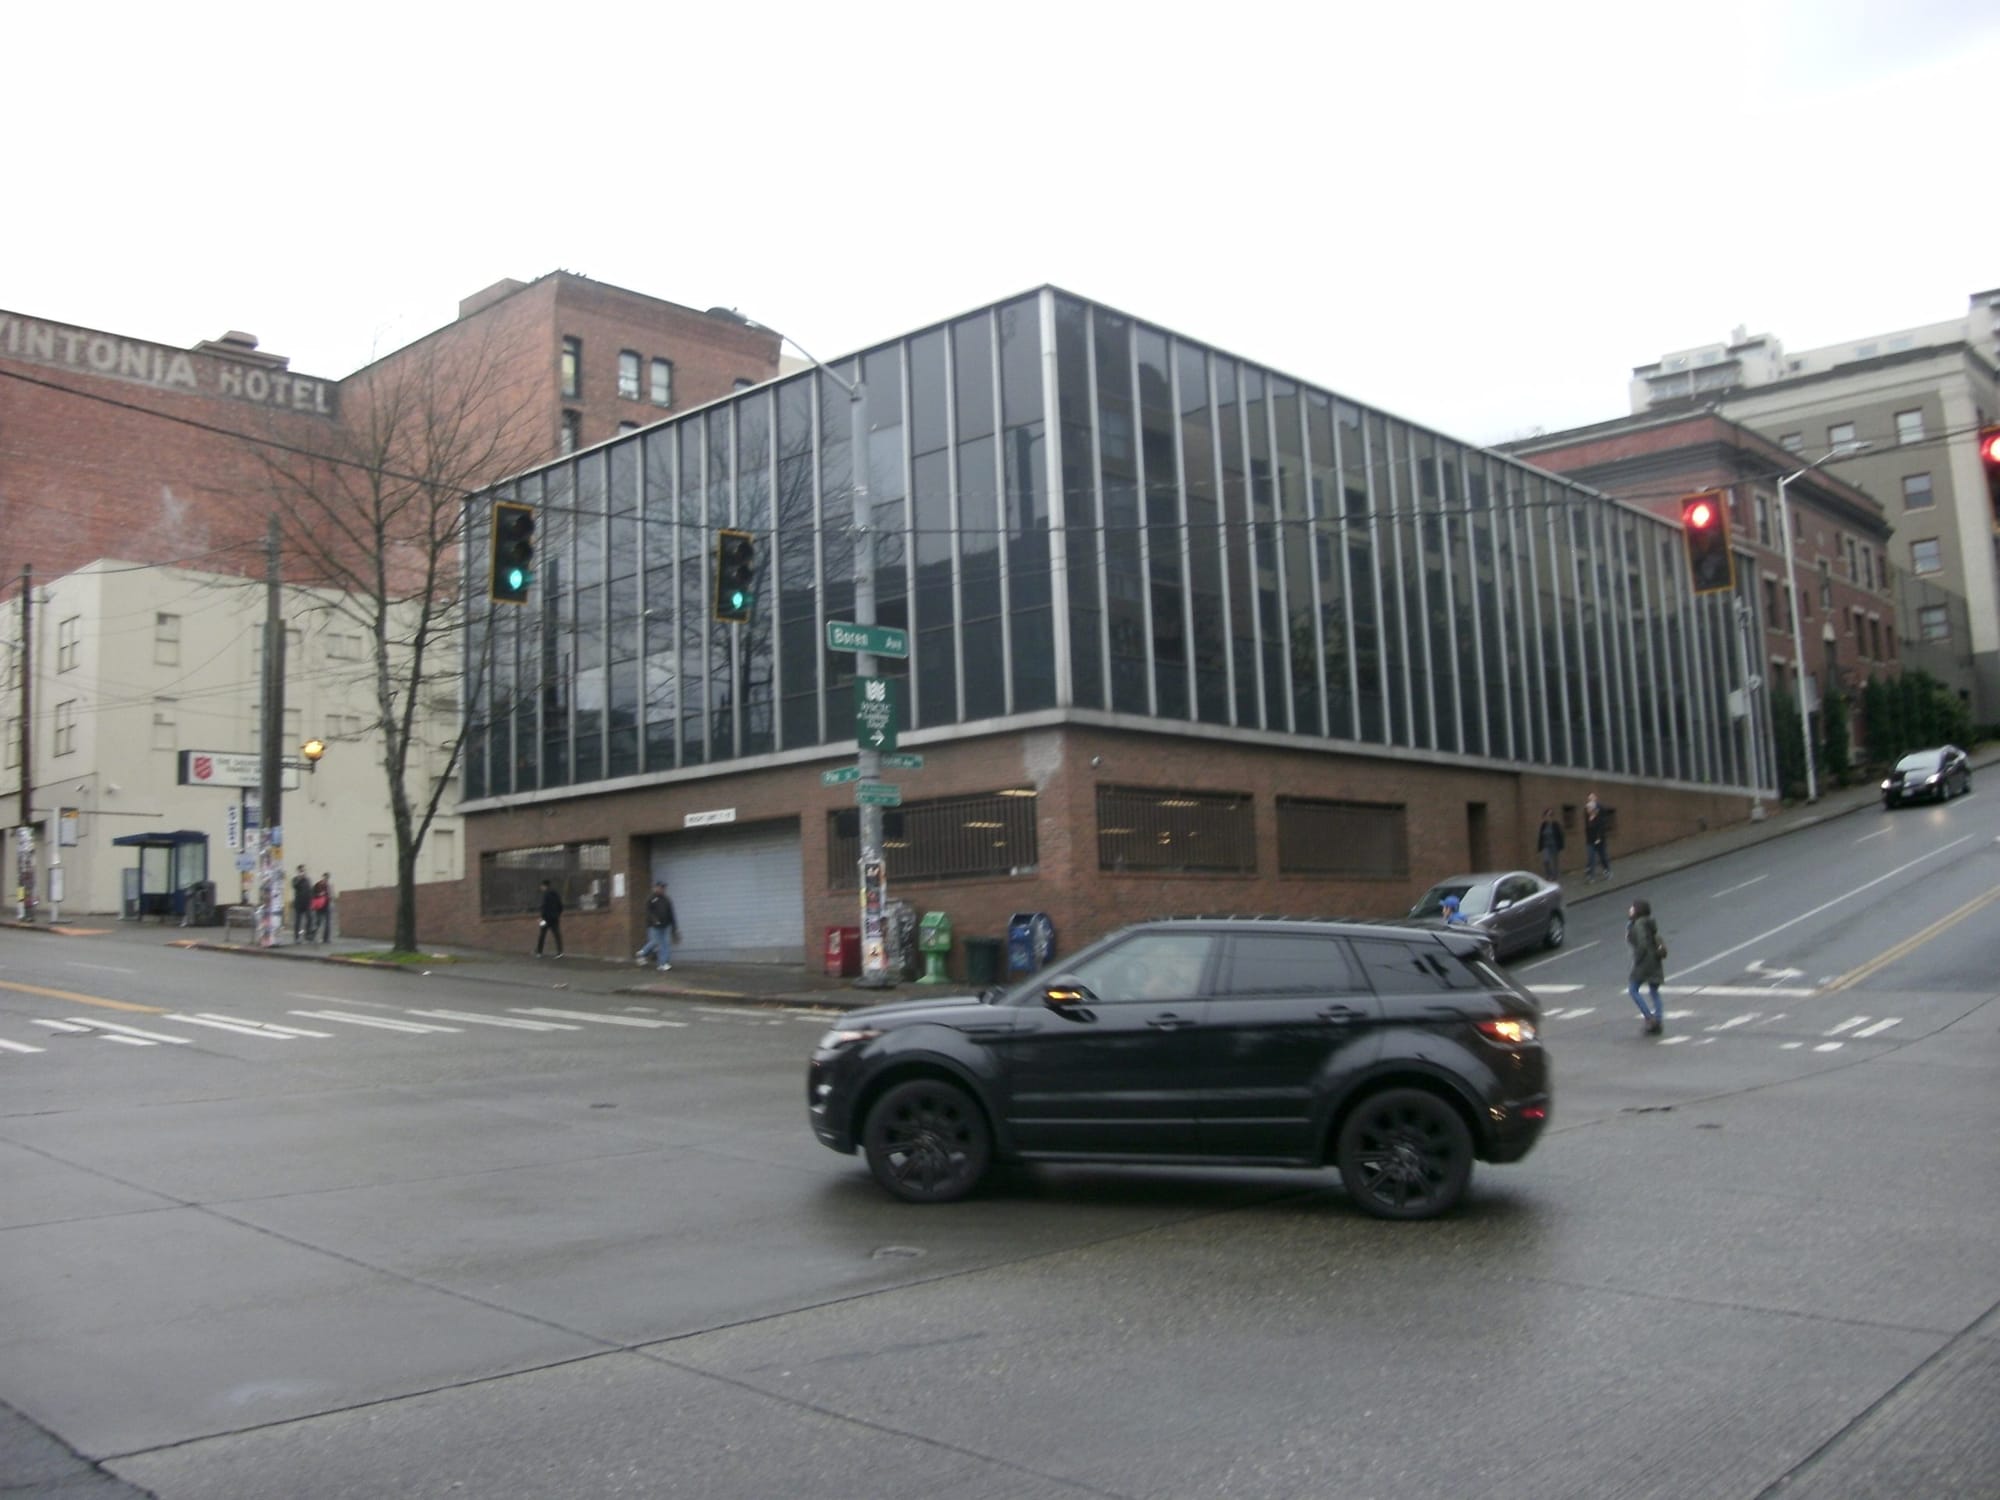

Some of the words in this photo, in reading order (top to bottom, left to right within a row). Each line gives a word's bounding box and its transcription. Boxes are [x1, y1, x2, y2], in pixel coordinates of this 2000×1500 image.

[219, 366, 332, 414] HOTEL
[833, 627, 869, 647] Boren
[885, 636, 903, 651] Ave
